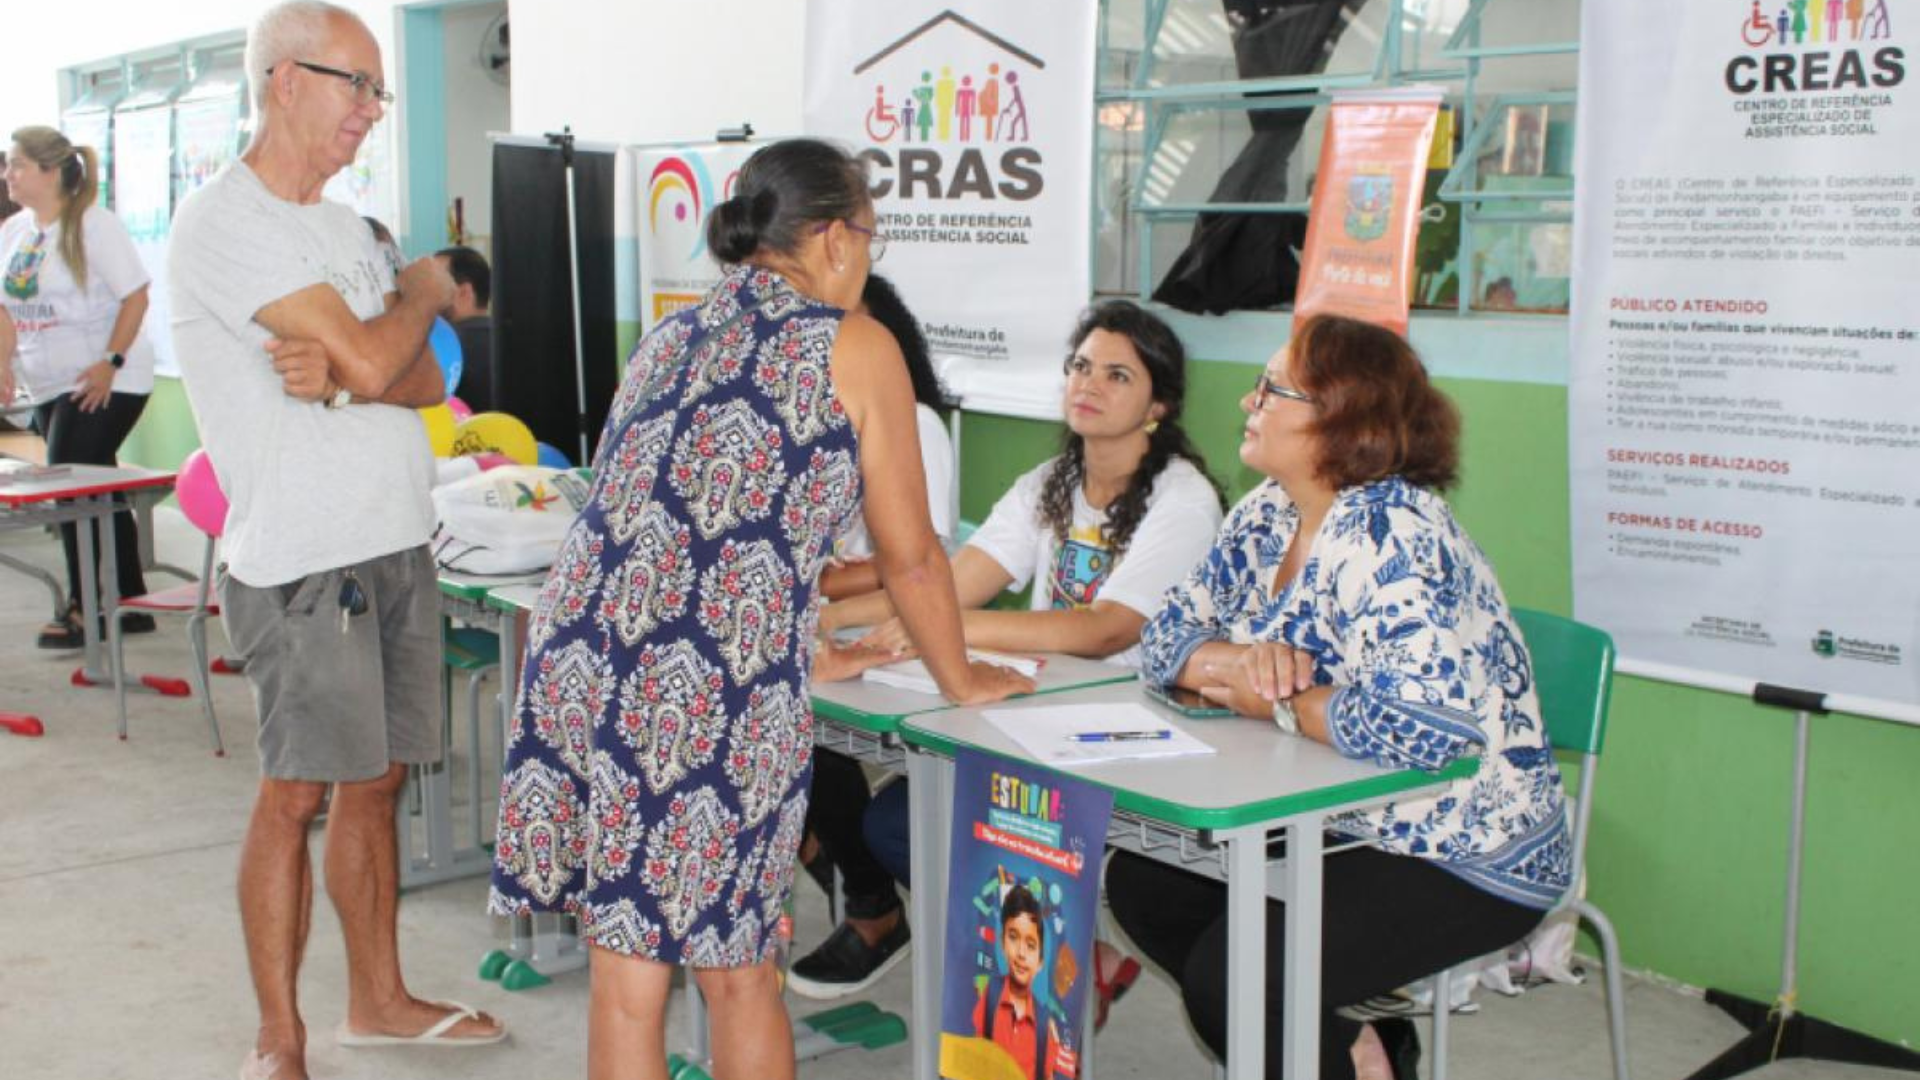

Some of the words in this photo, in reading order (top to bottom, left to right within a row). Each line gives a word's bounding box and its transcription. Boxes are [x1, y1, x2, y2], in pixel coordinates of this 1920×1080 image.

[1725, 46, 1905, 95] CREAS
[1734, 98, 1788, 112] CENTRO
[1790, 97, 1808, 110] DE
[1811, 93, 1892, 109] REFERÊNCIA
[1751, 110, 1851, 125] ESPECIALIZADO
[1854, 109, 1872, 121] DE
[1745, 123, 1827, 138] ASSISTÊNCIA
[1830, 123, 1876, 136] SOCIAL
[862, 147, 1044, 201] CRAS
[1732, 177, 1748, 188] de
[876, 213, 913, 227] NTRO
[916, 213, 937, 227] DE
[940, 212, 1033, 228] REFERÊNCIA
[884, 229, 972, 243] ASSISTÊNCIA
[975, 230, 1030, 245] SOCIAL
[1682, 299, 1768, 315] ATENDIDO
[926, 322, 986, 341] Prefeitura
[988, 326, 1005, 342] de
[1609, 318, 1655, 331] Pessoas
[1658, 320, 1689, 333] e/ou
[1743, 324, 1767, 334] que
[1770, 325, 1829, 337] vivenciam
[1832, 326, 1893, 340] situações
[1607, 448, 1686, 467] SERVIÇOS
[1689, 453, 1790, 475] REALIZADOS
[1819, 486, 1906, 508] Especializado
[1607, 511, 1673, 530] FORMAS
[1676, 517, 1697, 532] DE
[1702, 519, 1763, 540] ACESSO
